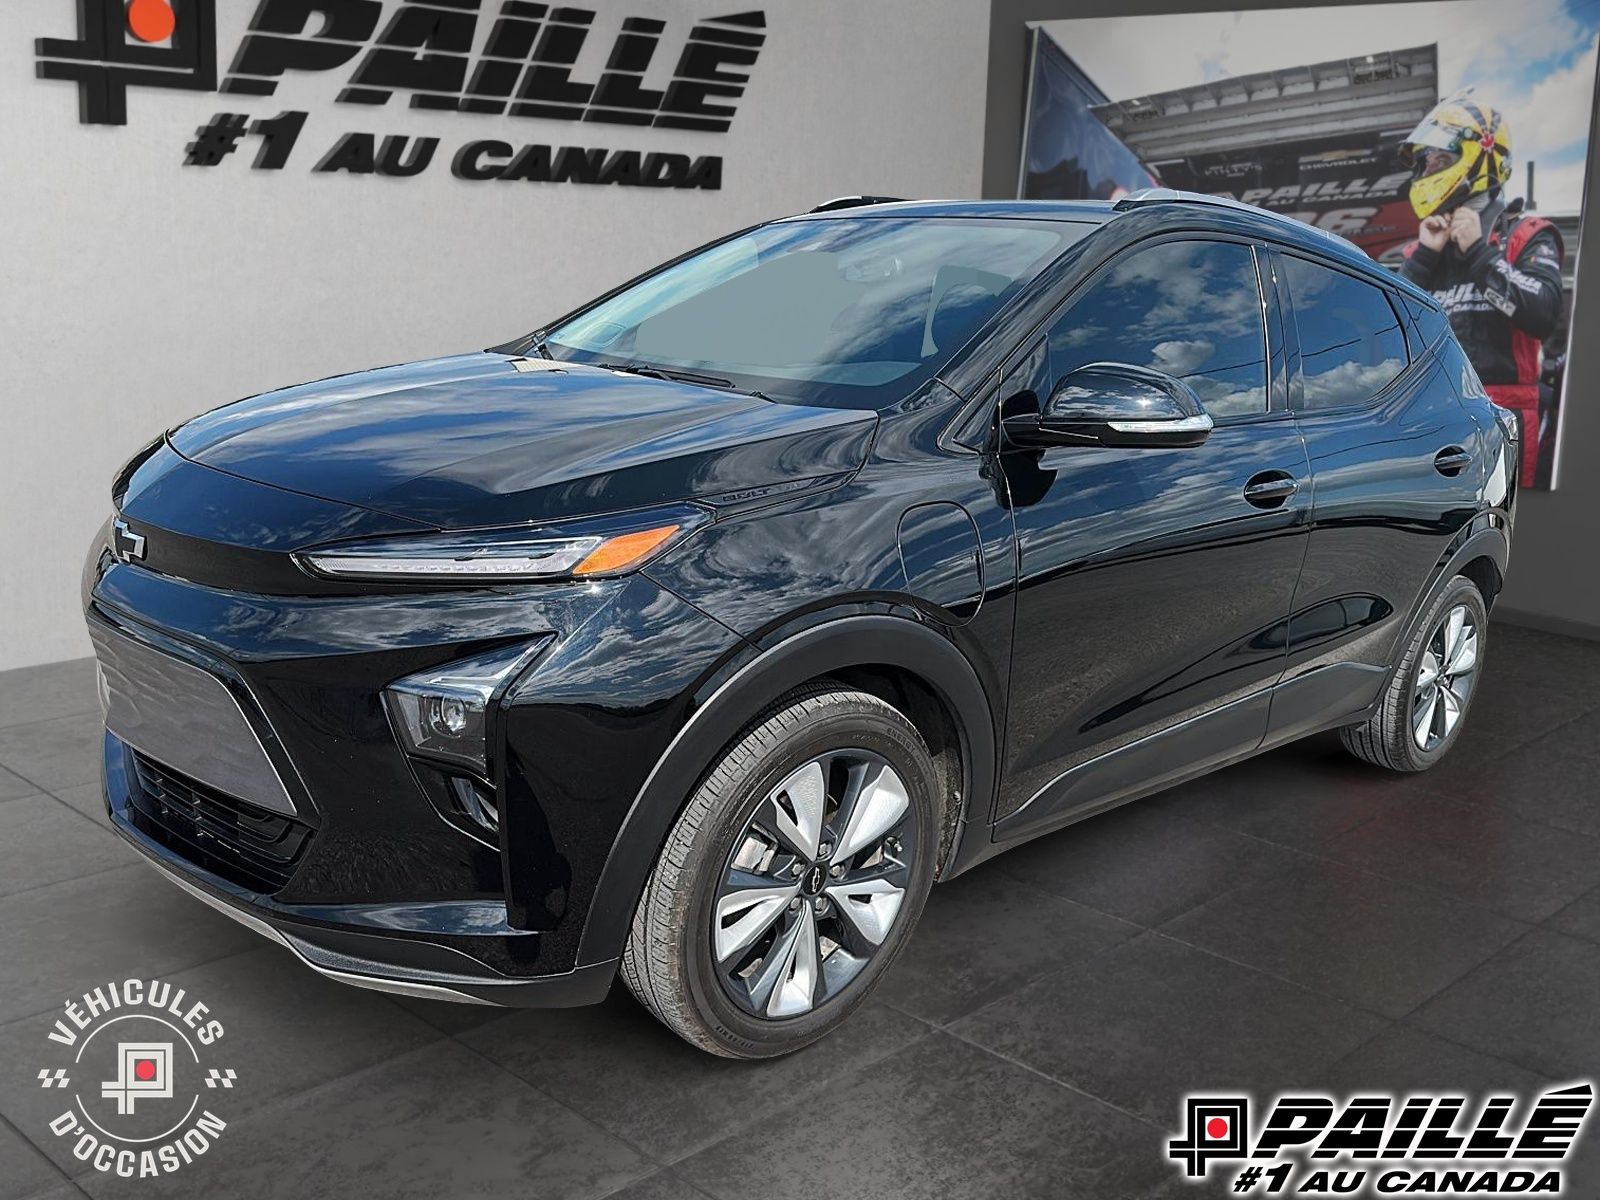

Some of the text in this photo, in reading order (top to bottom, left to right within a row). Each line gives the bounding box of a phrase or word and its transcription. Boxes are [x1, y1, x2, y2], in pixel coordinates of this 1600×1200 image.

[217, 0, 768, 132] PAILLÉ
[182, 110, 724, 190] #1 AU CANADA
[1299, 157, 1378, 171] CHEVROLET
[1302, 189, 1399, 204] CANADA
